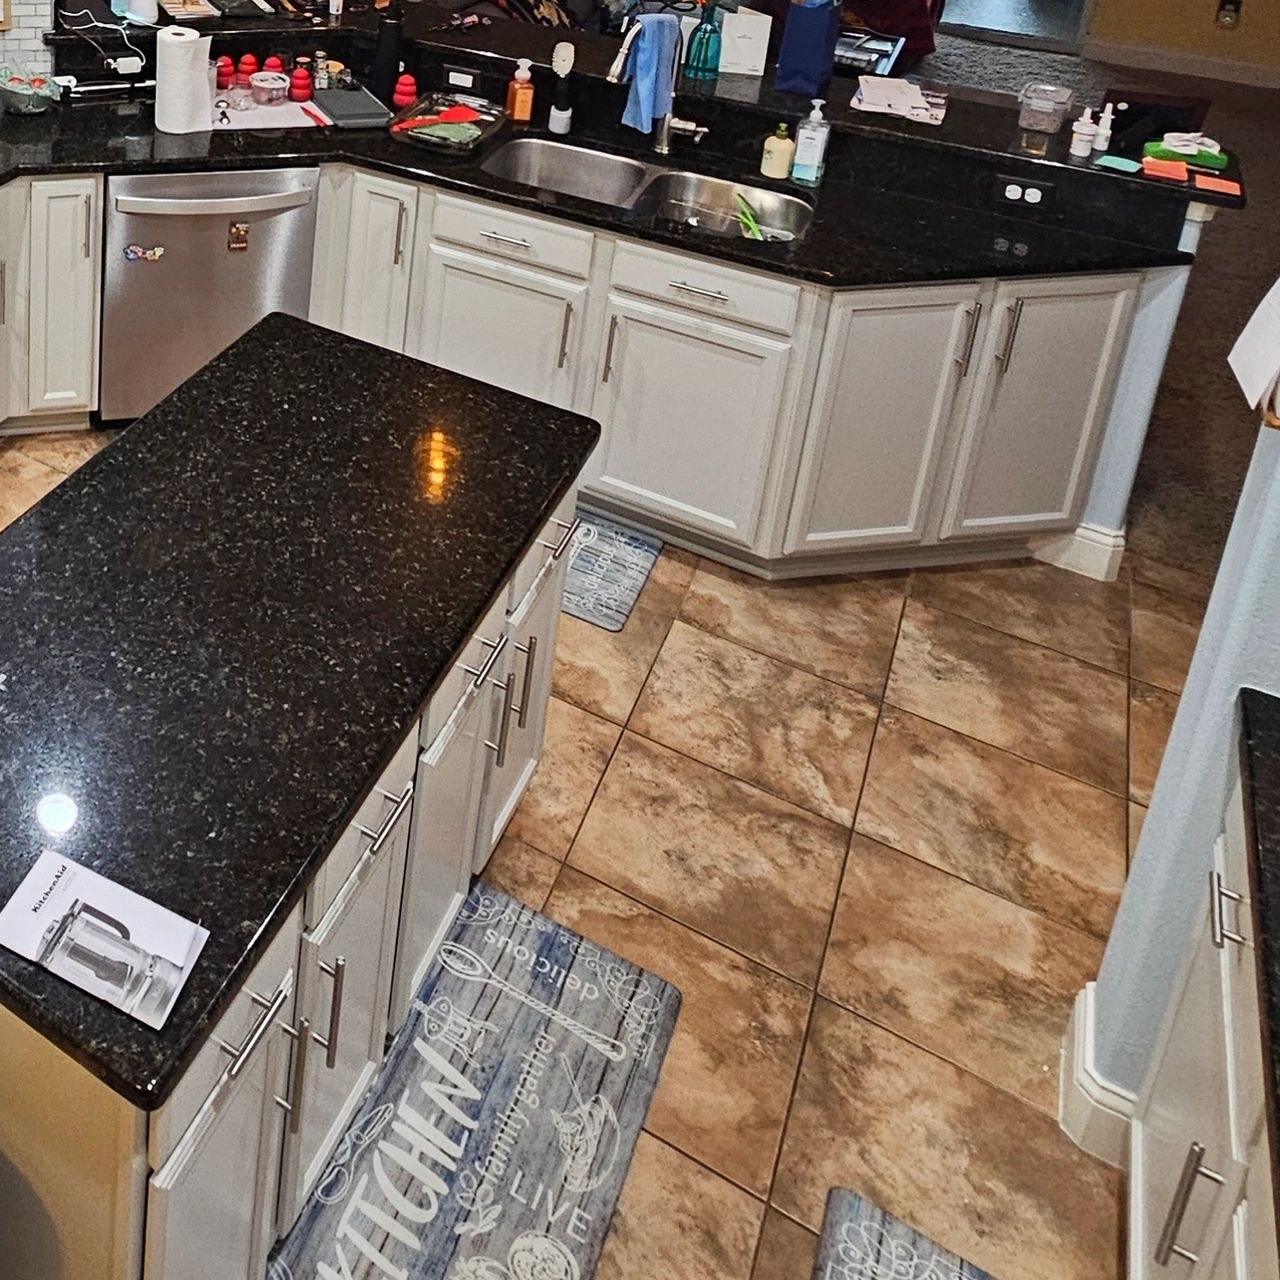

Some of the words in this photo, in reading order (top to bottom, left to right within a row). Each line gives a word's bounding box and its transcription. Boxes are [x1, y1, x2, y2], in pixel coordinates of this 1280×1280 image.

[31, 864, 68, 914] KitchenAid
[482, 926, 601, 1003] delicious
[475, 1104, 531, 1185] family
[515, 1028, 558, 1108] gather
[316, 1036, 483, 1280] KITCHEN
[509, 1170, 594, 1245] LIVE
